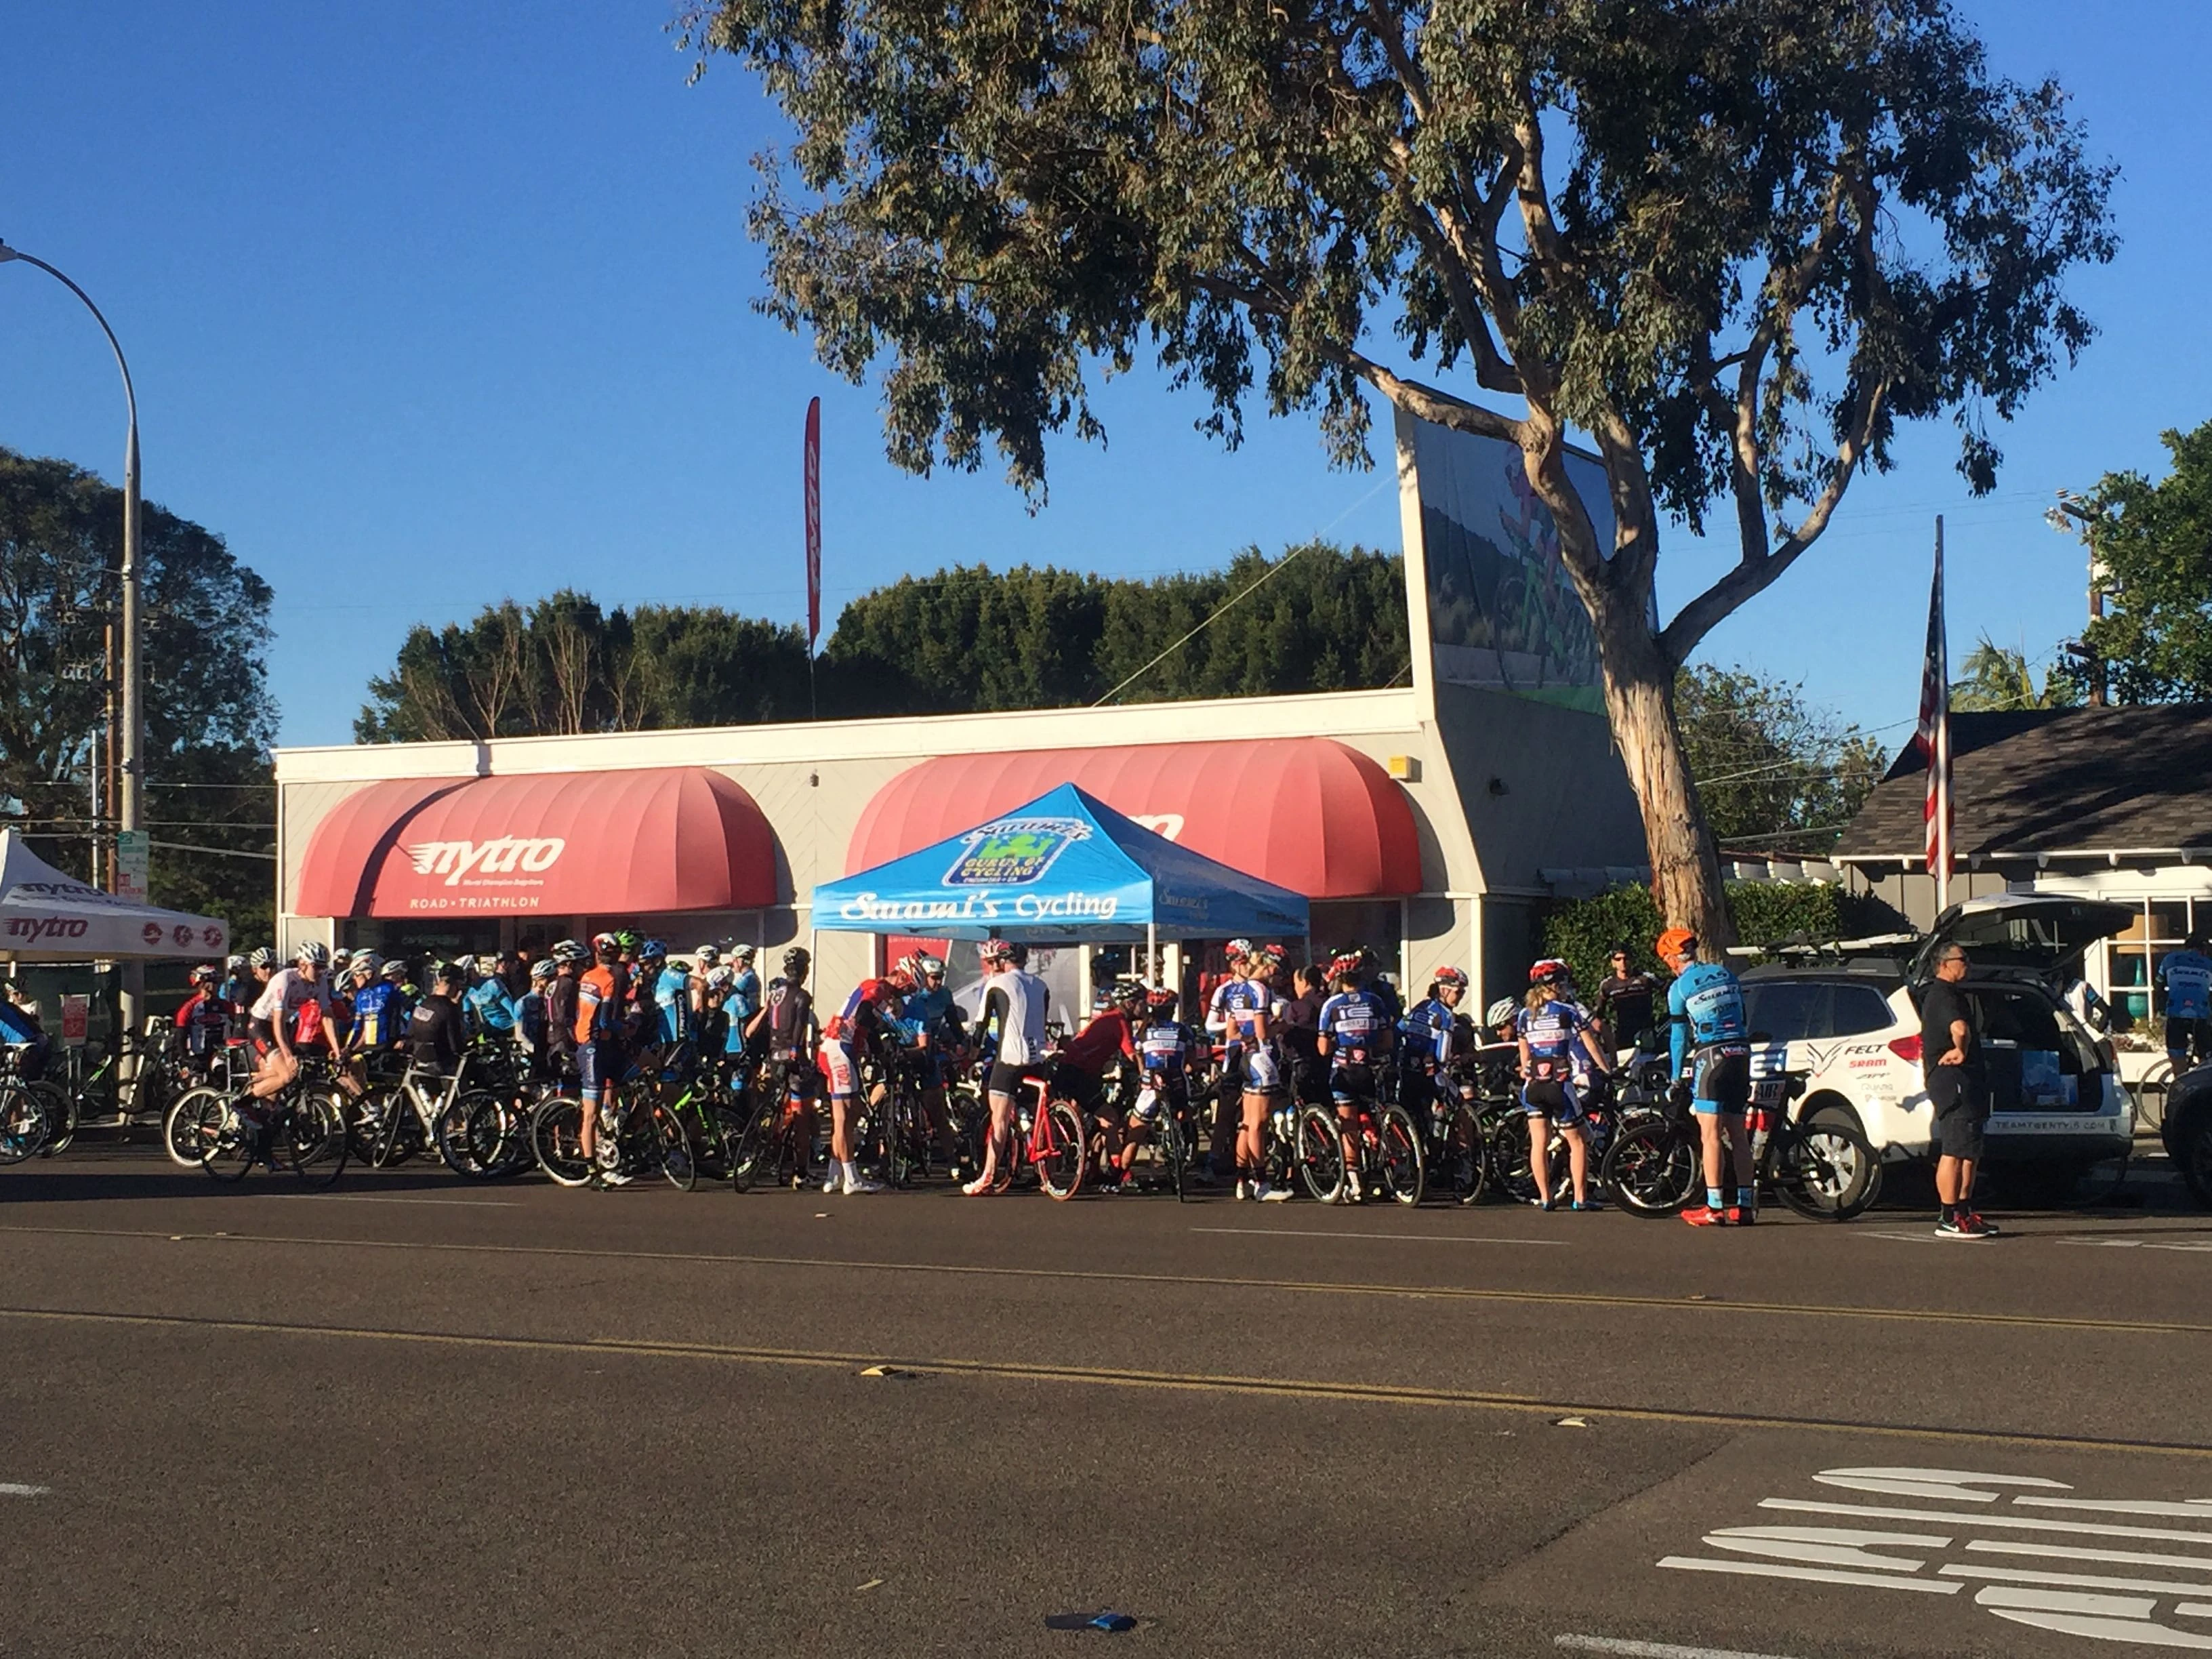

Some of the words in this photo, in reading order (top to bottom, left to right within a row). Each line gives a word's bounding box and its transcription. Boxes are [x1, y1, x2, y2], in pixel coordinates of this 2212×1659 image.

[407, 834, 565, 886] nytro
[960, 866, 1033, 878] CYCLING
[410, 899, 448, 909] ROAD
[459, 897, 539, 908] TRIATHLON
[840, 891, 1003, 920] Swami's
[1015, 892, 1118, 921] Cycling
[3, 916, 88, 943] nytro
[1844, 1044, 1888, 1055] FELT
[1848, 1059, 1887, 1068] SRAM
